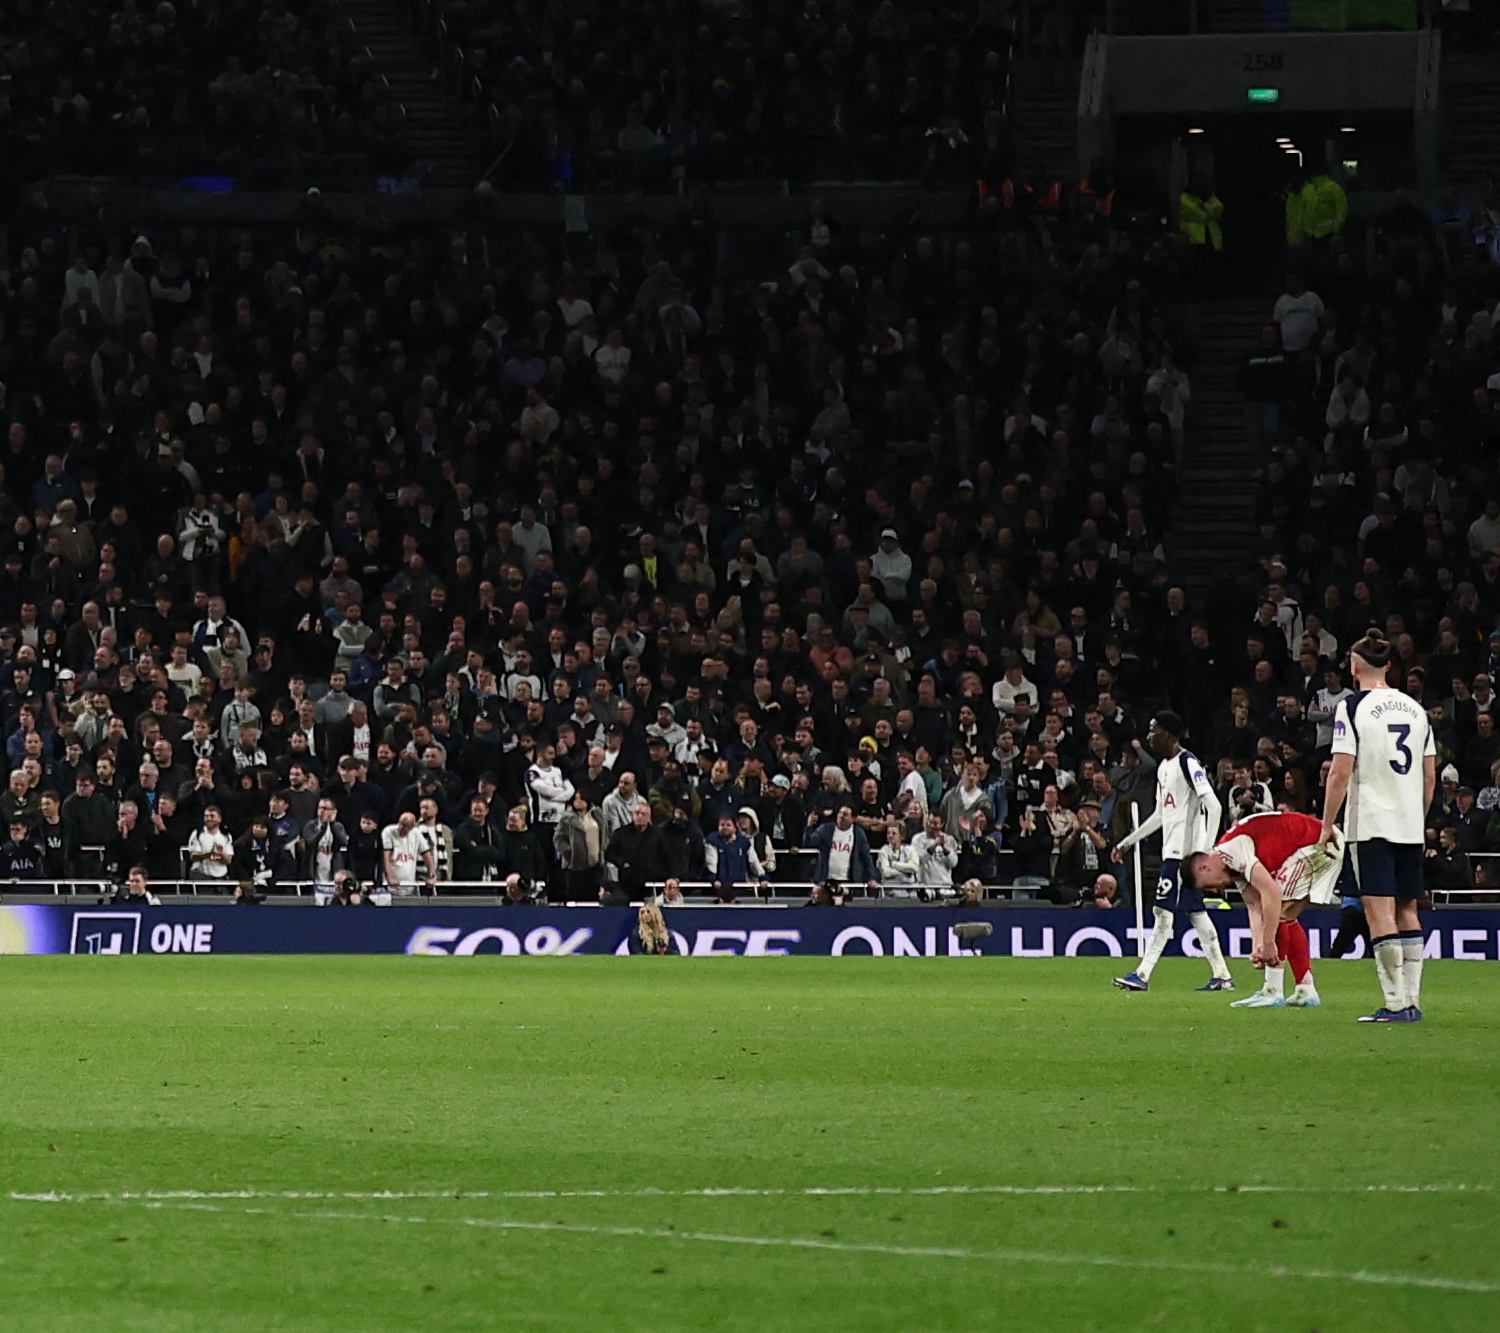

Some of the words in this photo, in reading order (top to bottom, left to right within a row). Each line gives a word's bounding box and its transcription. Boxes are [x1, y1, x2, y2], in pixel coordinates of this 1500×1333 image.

[1242, 53, 1284, 71] 258
[1387, 723, 1414, 776] 3
[829, 841, 851, 853] AIA
[396, 852, 415, 863] AIA
[11, 860, 35, 871] AIA
[151, 923, 214, 953] ONE
